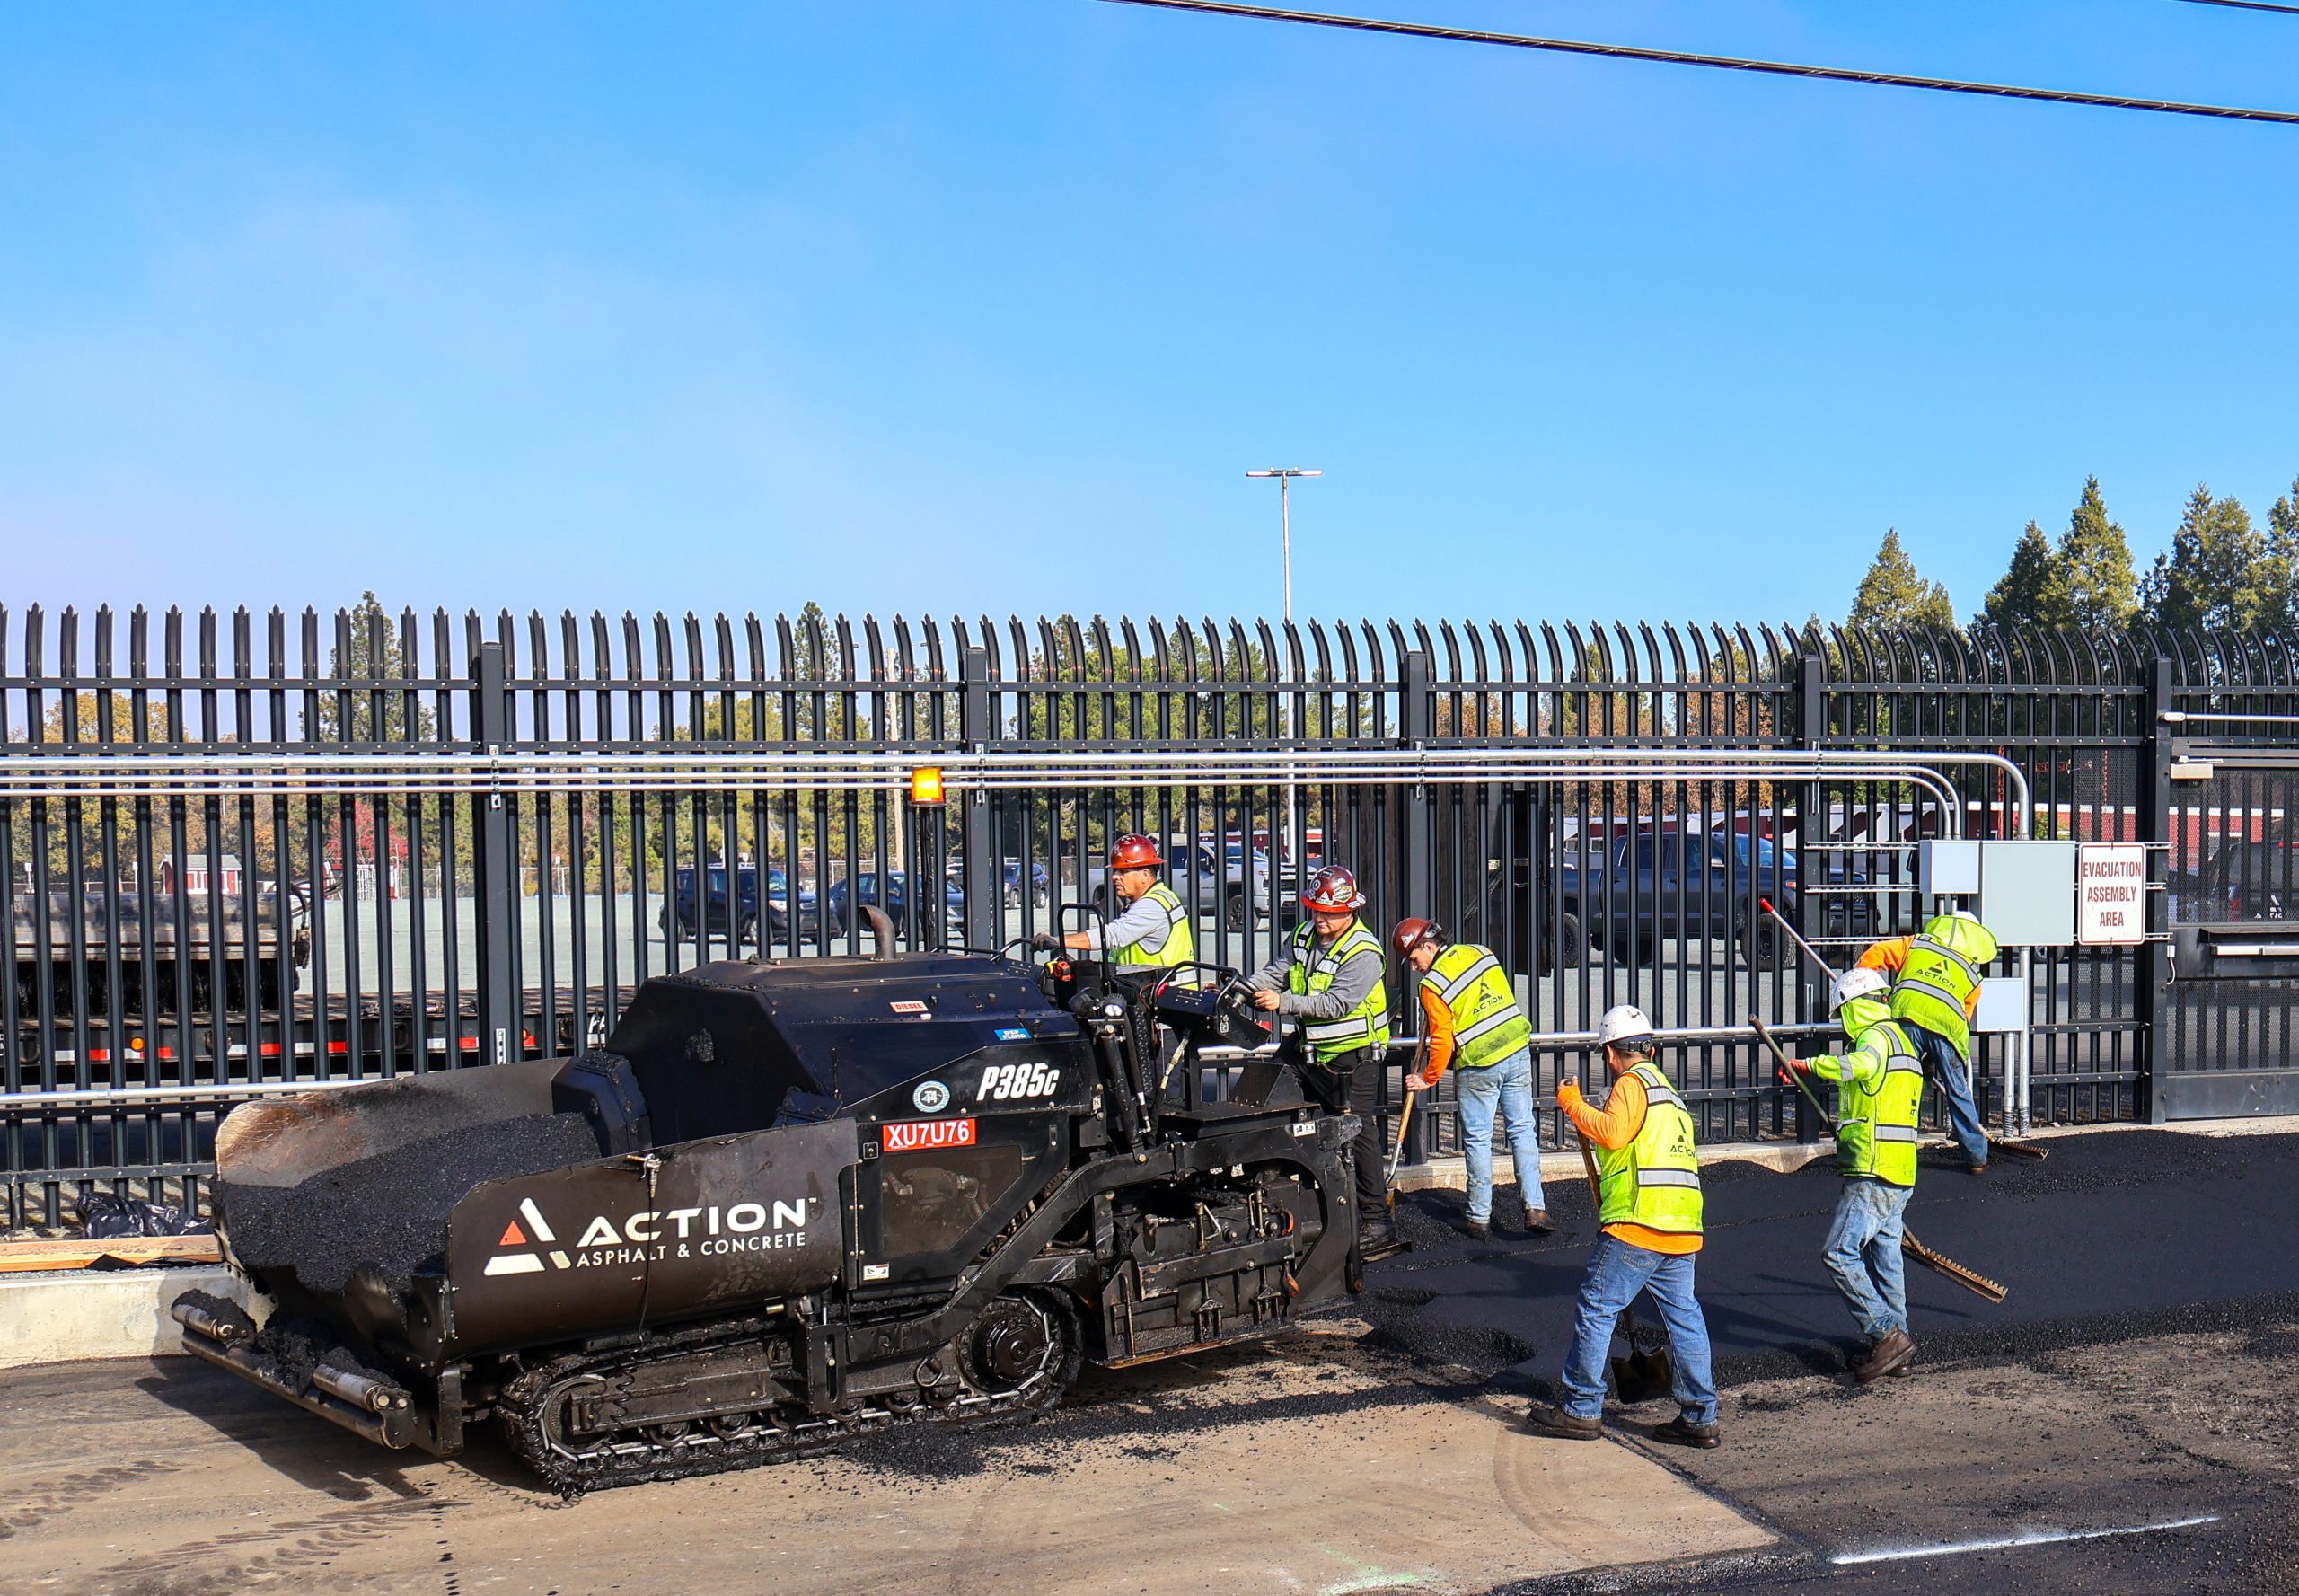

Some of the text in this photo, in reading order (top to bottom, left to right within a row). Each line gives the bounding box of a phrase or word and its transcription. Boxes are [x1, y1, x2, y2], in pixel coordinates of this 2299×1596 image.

[2083, 861, 2142, 877] EVACUATION
[2087, 886, 2137, 903] ASSEMBLY
[2099, 911, 2125, 927] AREA
[1916, 968, 1956, 989] ACTION
[894, 1002, 923, 1010] DIESEL
[887, 1120, 970, 1148] XU7U76
[576, 1198, 806, 1248] ACTION
[576, 1231, 806, 1268] ASPHALT & CONCRETE
